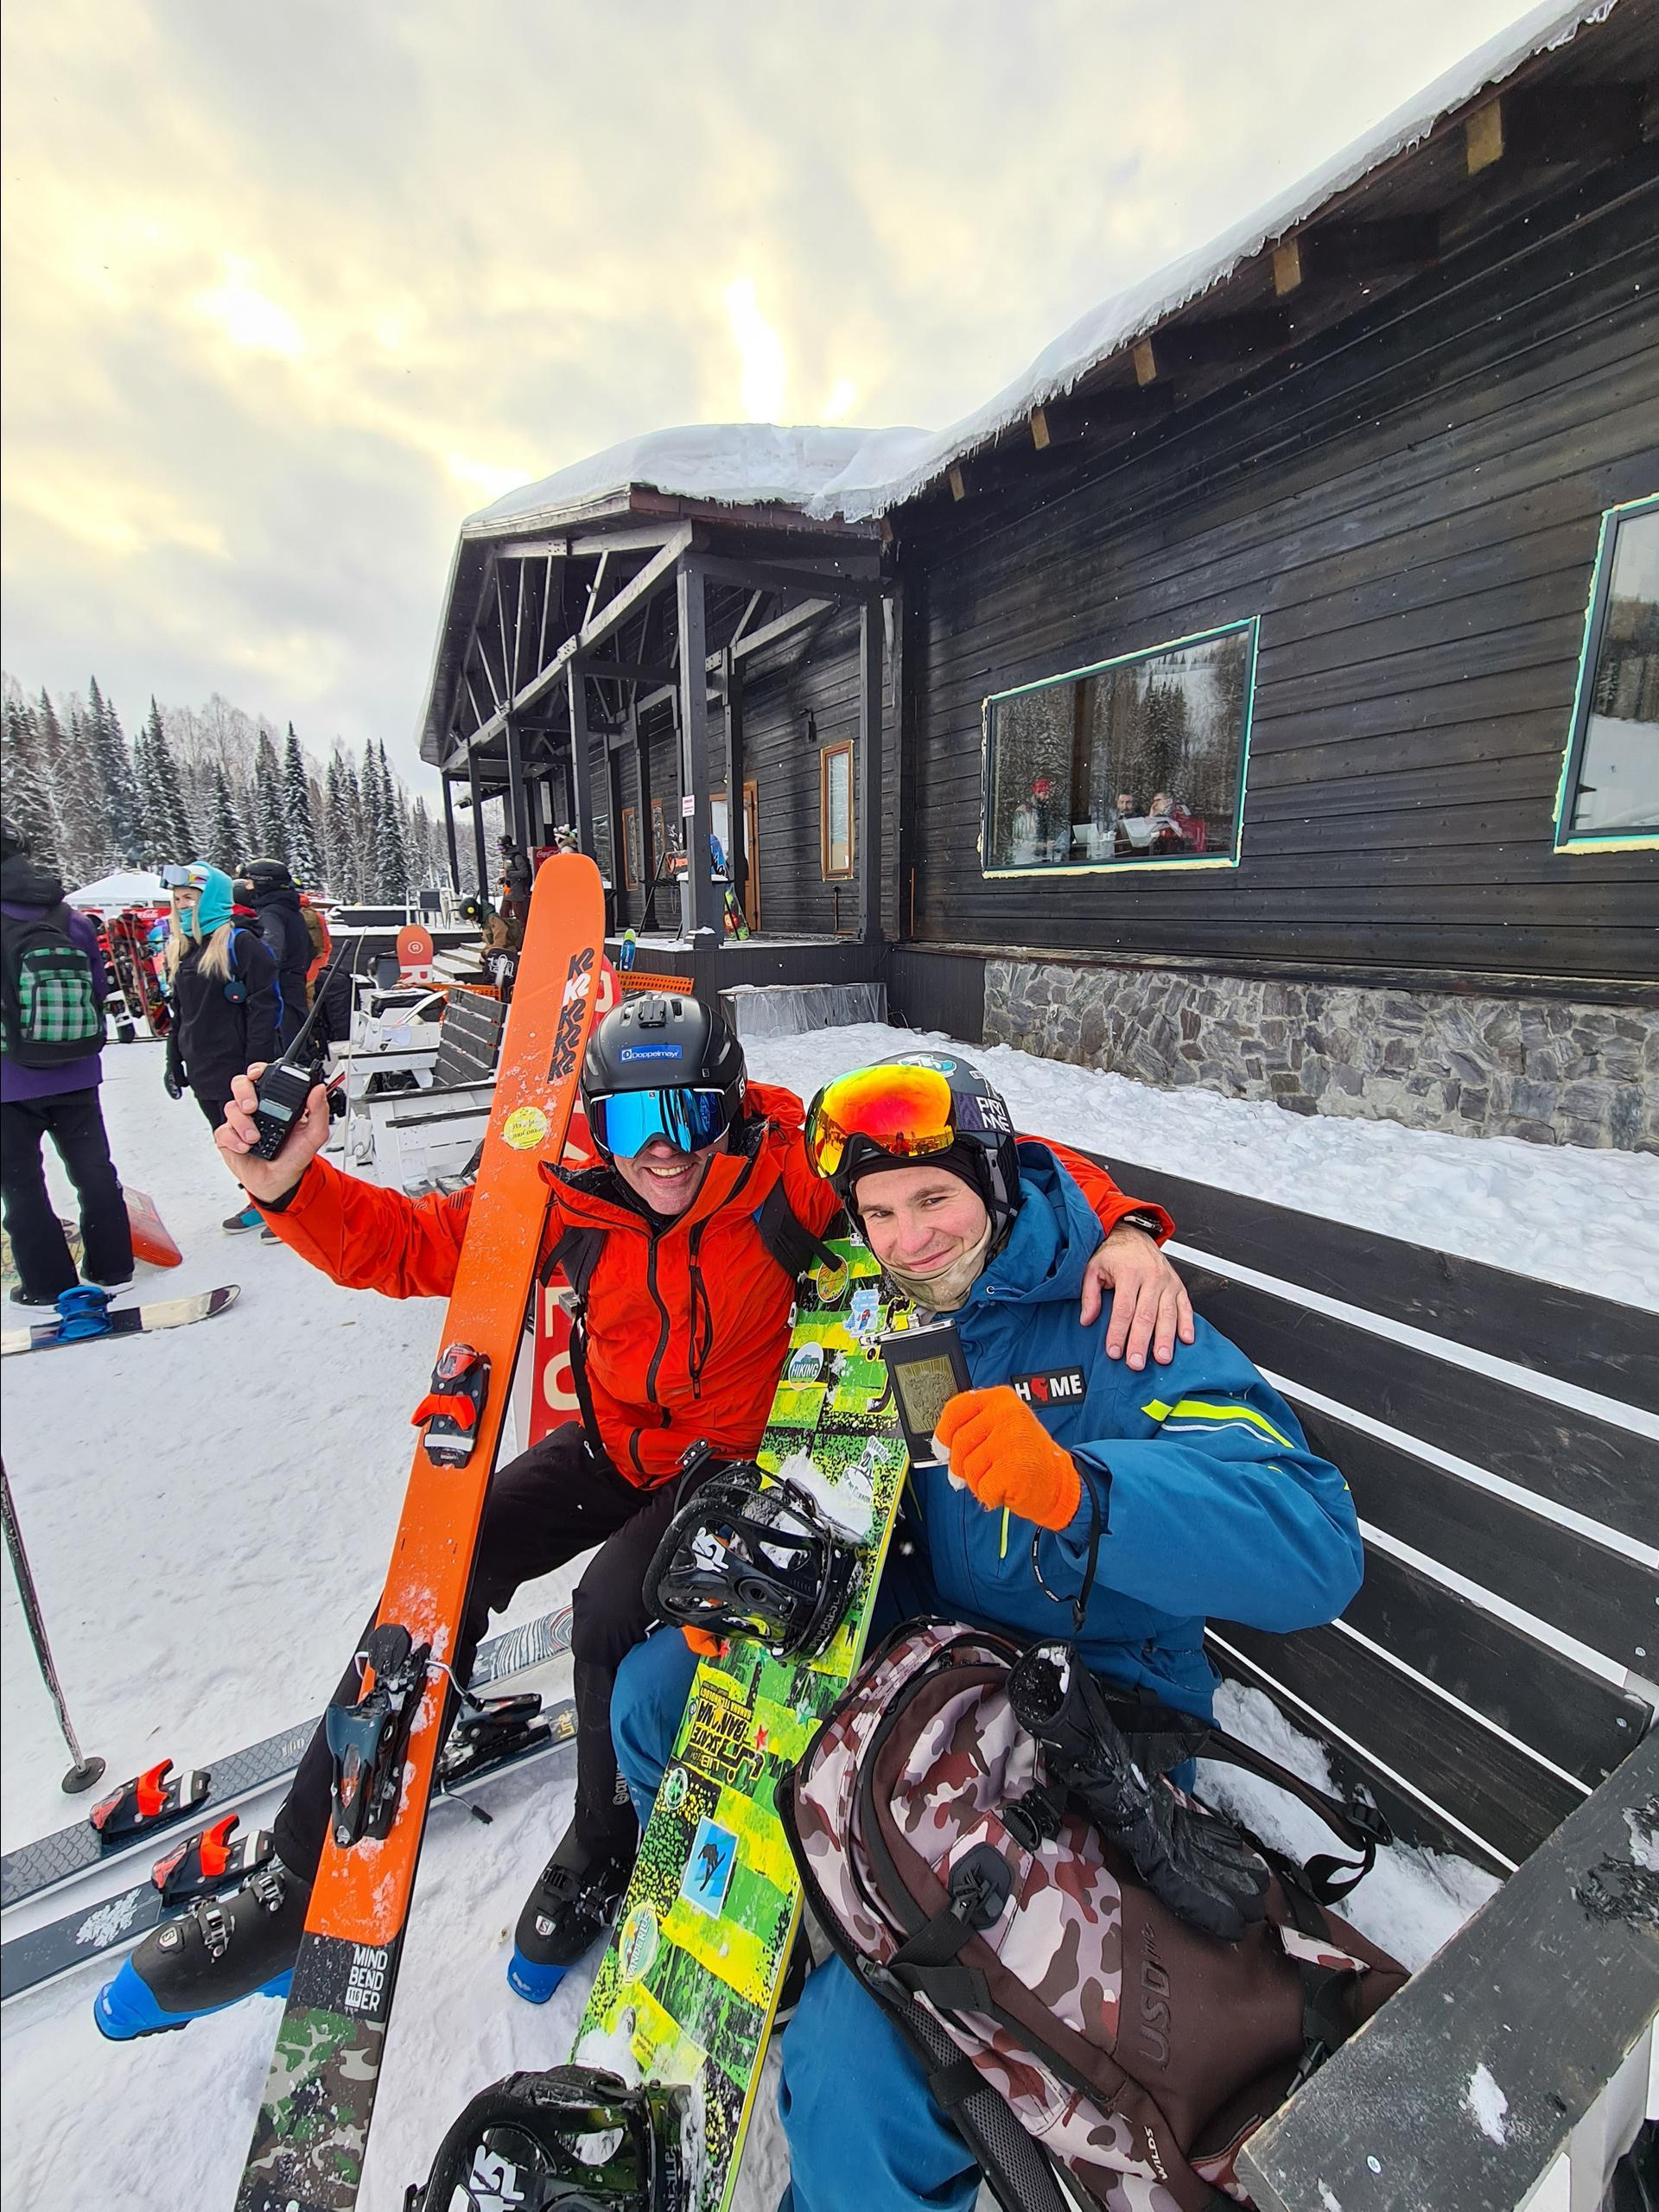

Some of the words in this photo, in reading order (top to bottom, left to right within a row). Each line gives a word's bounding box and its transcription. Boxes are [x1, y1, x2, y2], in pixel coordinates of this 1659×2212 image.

[568, 948, 594, 980] K2
[562, 973, 591, 1007] K2
[558, 999, 586, 1031] K2
[553, 1025, 581, 1058] K2
[632, 1049, 679, 1059] Doppelmayr
[547, 1051, 576, 1084] K2
[791, 1362, 819, 1378] HIKING
[691, 1726, 722, 1757] SKATE
[701, 1755, 722, 1771] LIB
[353, 1946, 389, 1971] MIND
[626, 1907, 654, 1984] WANDERLUST
[348, 1965, 385, 1992] BEND
[360, 1989, 380, 2012] ER
[1140, 1960, 1171, 2072] USD
